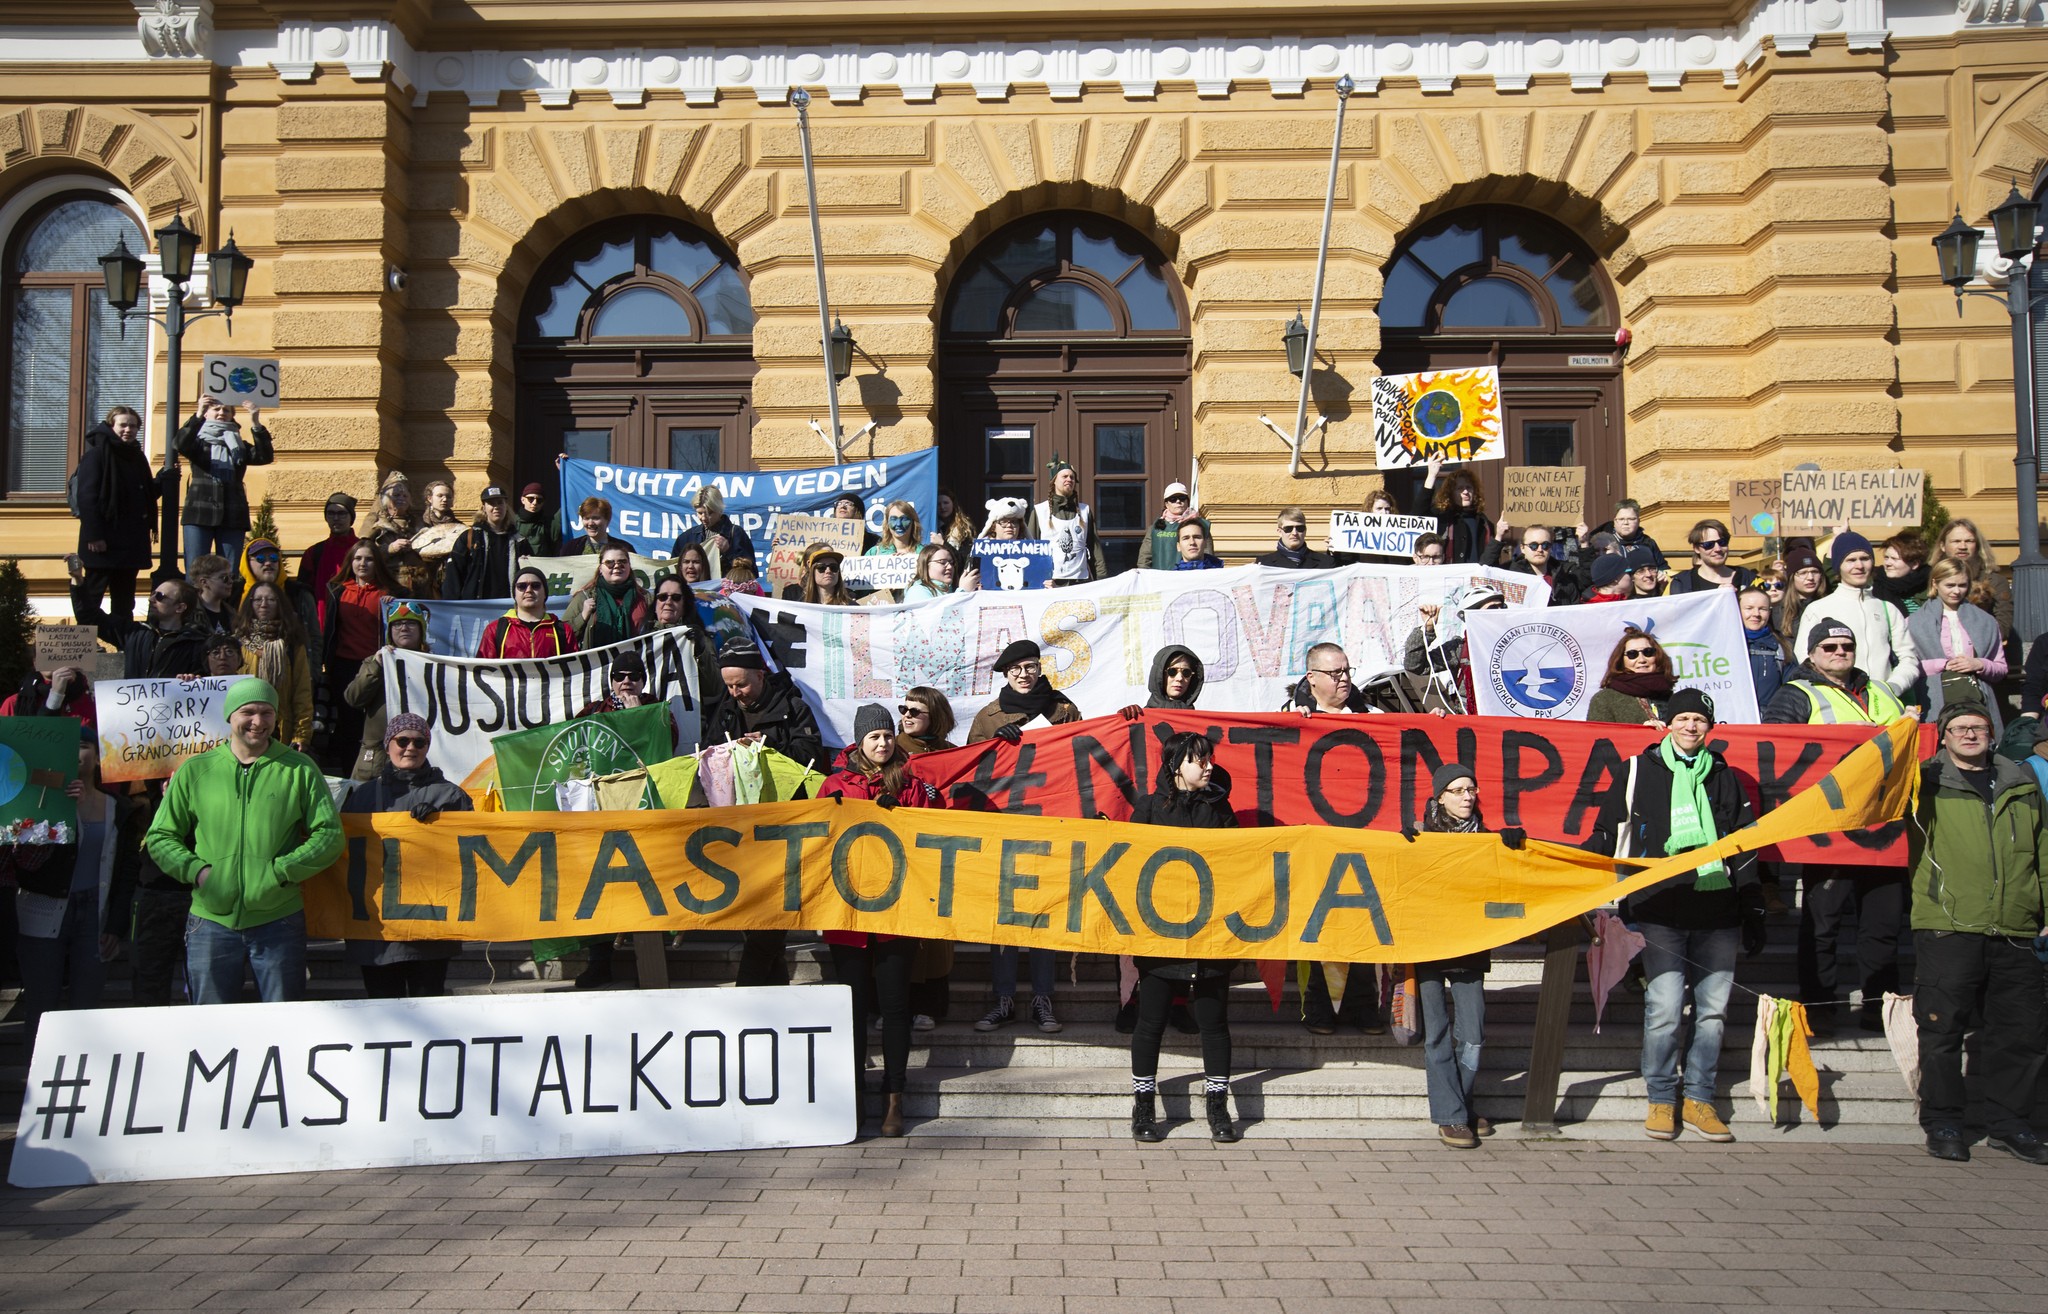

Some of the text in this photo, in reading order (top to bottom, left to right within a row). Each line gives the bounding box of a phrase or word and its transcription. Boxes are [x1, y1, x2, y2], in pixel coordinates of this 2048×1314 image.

[1372, 377, 1416, 411] RADIKAALI
[1375, 407, 1418, 447] POLITIIKKA
[593, 462, 888, 499] PUHTAAN VEDEN
[1507, 471, 1525, 484] YOU
[1553, 470, 1576, 482] EAT
[1831, 472, 1857, 491] LEA
[1860, 472, 1921, 491] EALLIN
[1507, 485, 1582, 498] MONEY WHEN THE
[1735, 480, 1782, 497] RESP
[1505, 499, 1582, 514] WORLD COLLAPSES
[1851, 492, 1917, 520] ELÄMÄ
[780, 519, 855, 536] MENNYTTÄ EI
[1333, 511, 1435, 531] TÄÄ ON MEIDÄN
[778, 533, 806, 548] SAA
[1341, 529, 1422, 554] TALVISOT
[842, 556, 917, 573] MITÄ LAPSE
[843, 572, 918, 587] ÄÄNESTÄIS
[1522, 624, 1583, 668] LINTUTIETEELLINEN
[1565, 669, 1585, 707] YHDISTYS
[1676, 652, 1730, 680] Life
[116, 678, 228, 706] START SAYING
[1534, 709, 1553, 718] PPLY
[133, 720, 206, 741] TO YOUR
[122, 738, 230, 763] GRANDCHILDRE
[347, 819, 1395, 947] ILMASTOTEKOJA
[35, 1025, 833, 1141] #ILMASTOTALKOOT
